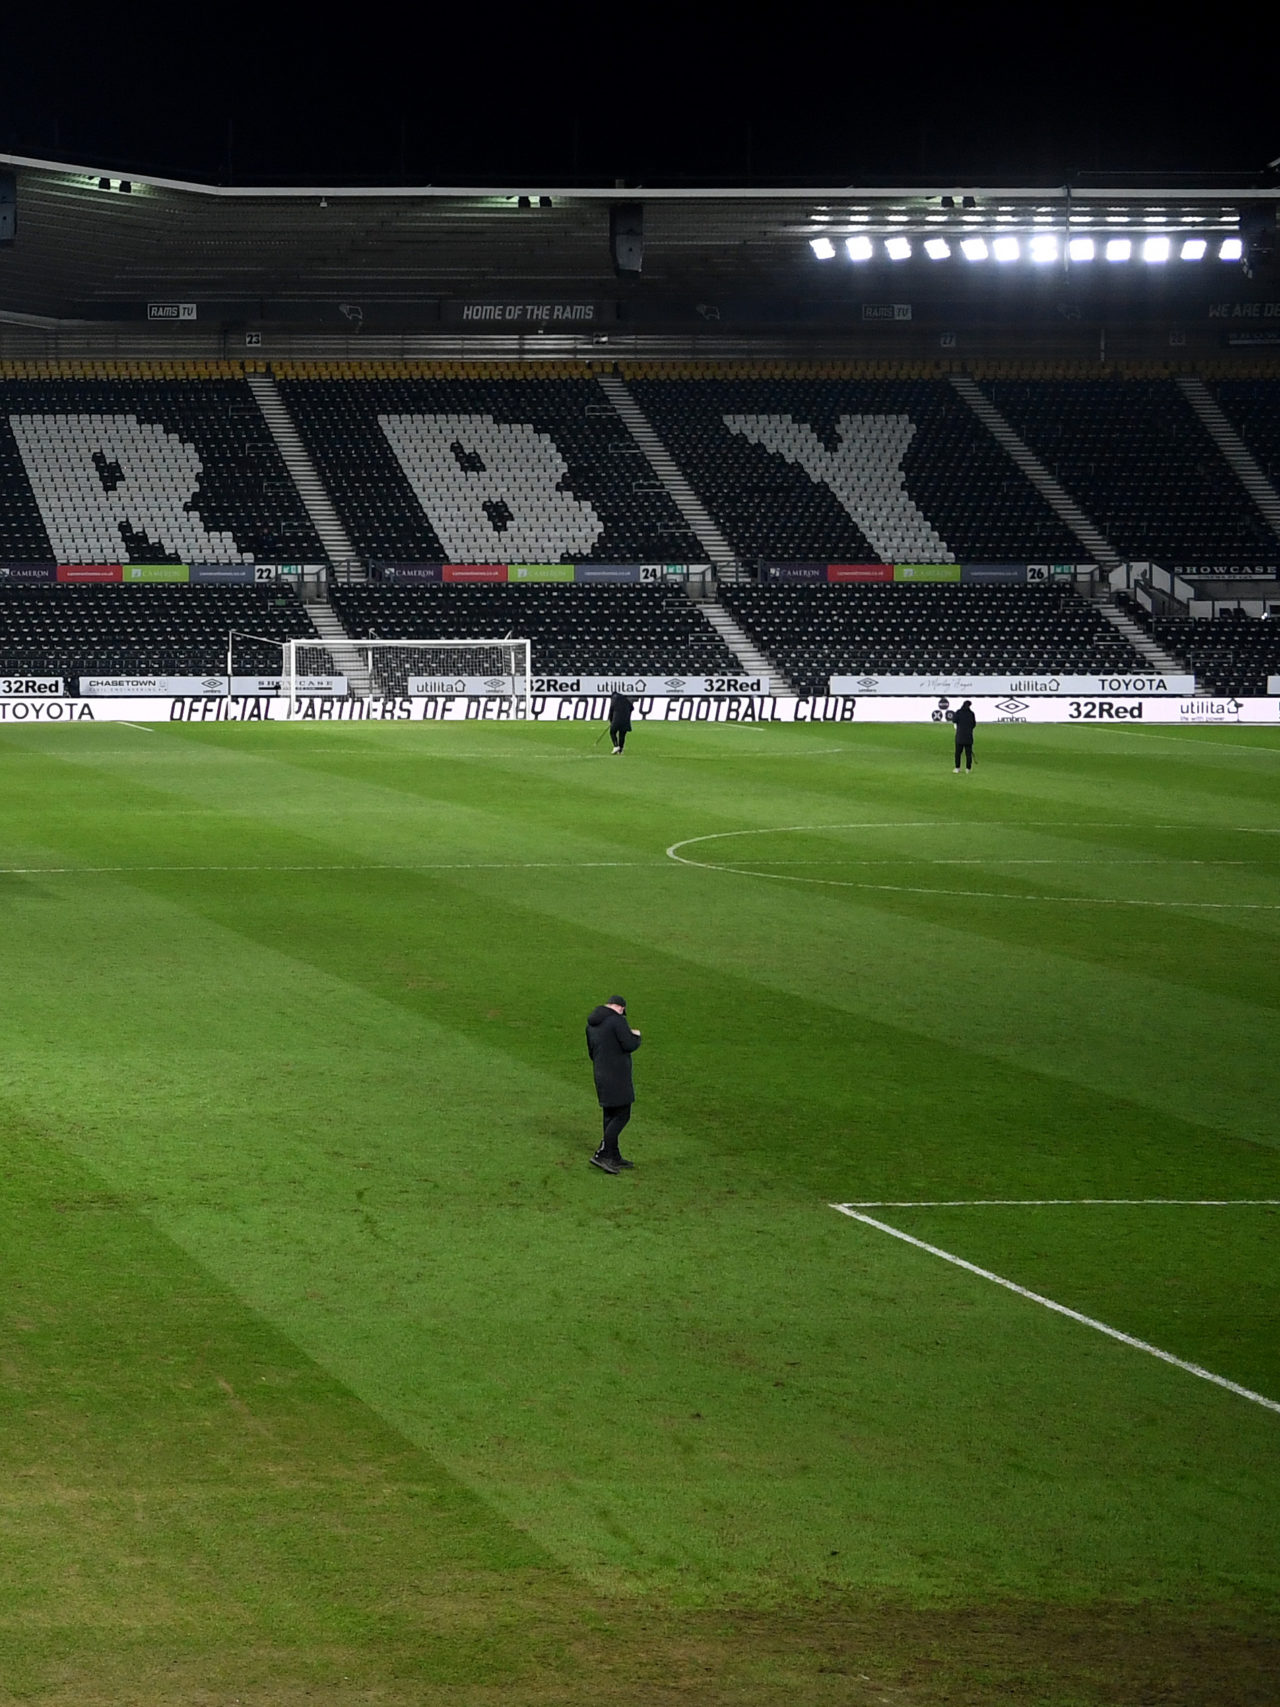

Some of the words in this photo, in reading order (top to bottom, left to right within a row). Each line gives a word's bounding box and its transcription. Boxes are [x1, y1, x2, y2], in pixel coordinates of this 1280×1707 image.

[150, 306, 178, 317] RAMS
[182, 306, 194, 316] TV
[463, 305, 504, 320] HOME
[505, 305, 524, 320] OF
[525, 305, 552, 320] THE
[552, 305, 594, 320] RAMS
[1208, 304, 1231, 318] WE
[1232, 304, 1262, 318] ARE
[247, 334, 260, 345] 23
[10, 570, 49, 578] CAMERON
[256, 568, 272, 580] 22
[396, 570, 434, 578] CAMERON
[642, 568, 657, 580] 24
[780, 570, 820, 578] CAMERON
[1028, 568, 1044, 580] 26
[1174, 566, 1278, 574] SHOWCASE
[2, 680, 60, 694] 32Red
[89, 680, 156, 688] CHASETOWN
[416, 680, 454, 693] utilita
[597, 680, 634, 693] utilita
[704, 679, 761, 693] 32Red
[1010, 680, 1048, 692] utilita
[1098, 678, 1168, 692] TOYOTA
[170, 698, 275, 722] OFFICIAL
[286, 698, 413, 721] PARTNERS
[423, 698, 456, 720] OF
[465, 698, 547, 720] DERBY
[557, 698, 655, 721] COUY
[665, 698, 782, 722] FOOTBALL
[794, 698, 857, 722] CLUB
[1068, 701, 1144, 719] 32Red
[1180, 702, 1226, 714] utilita
